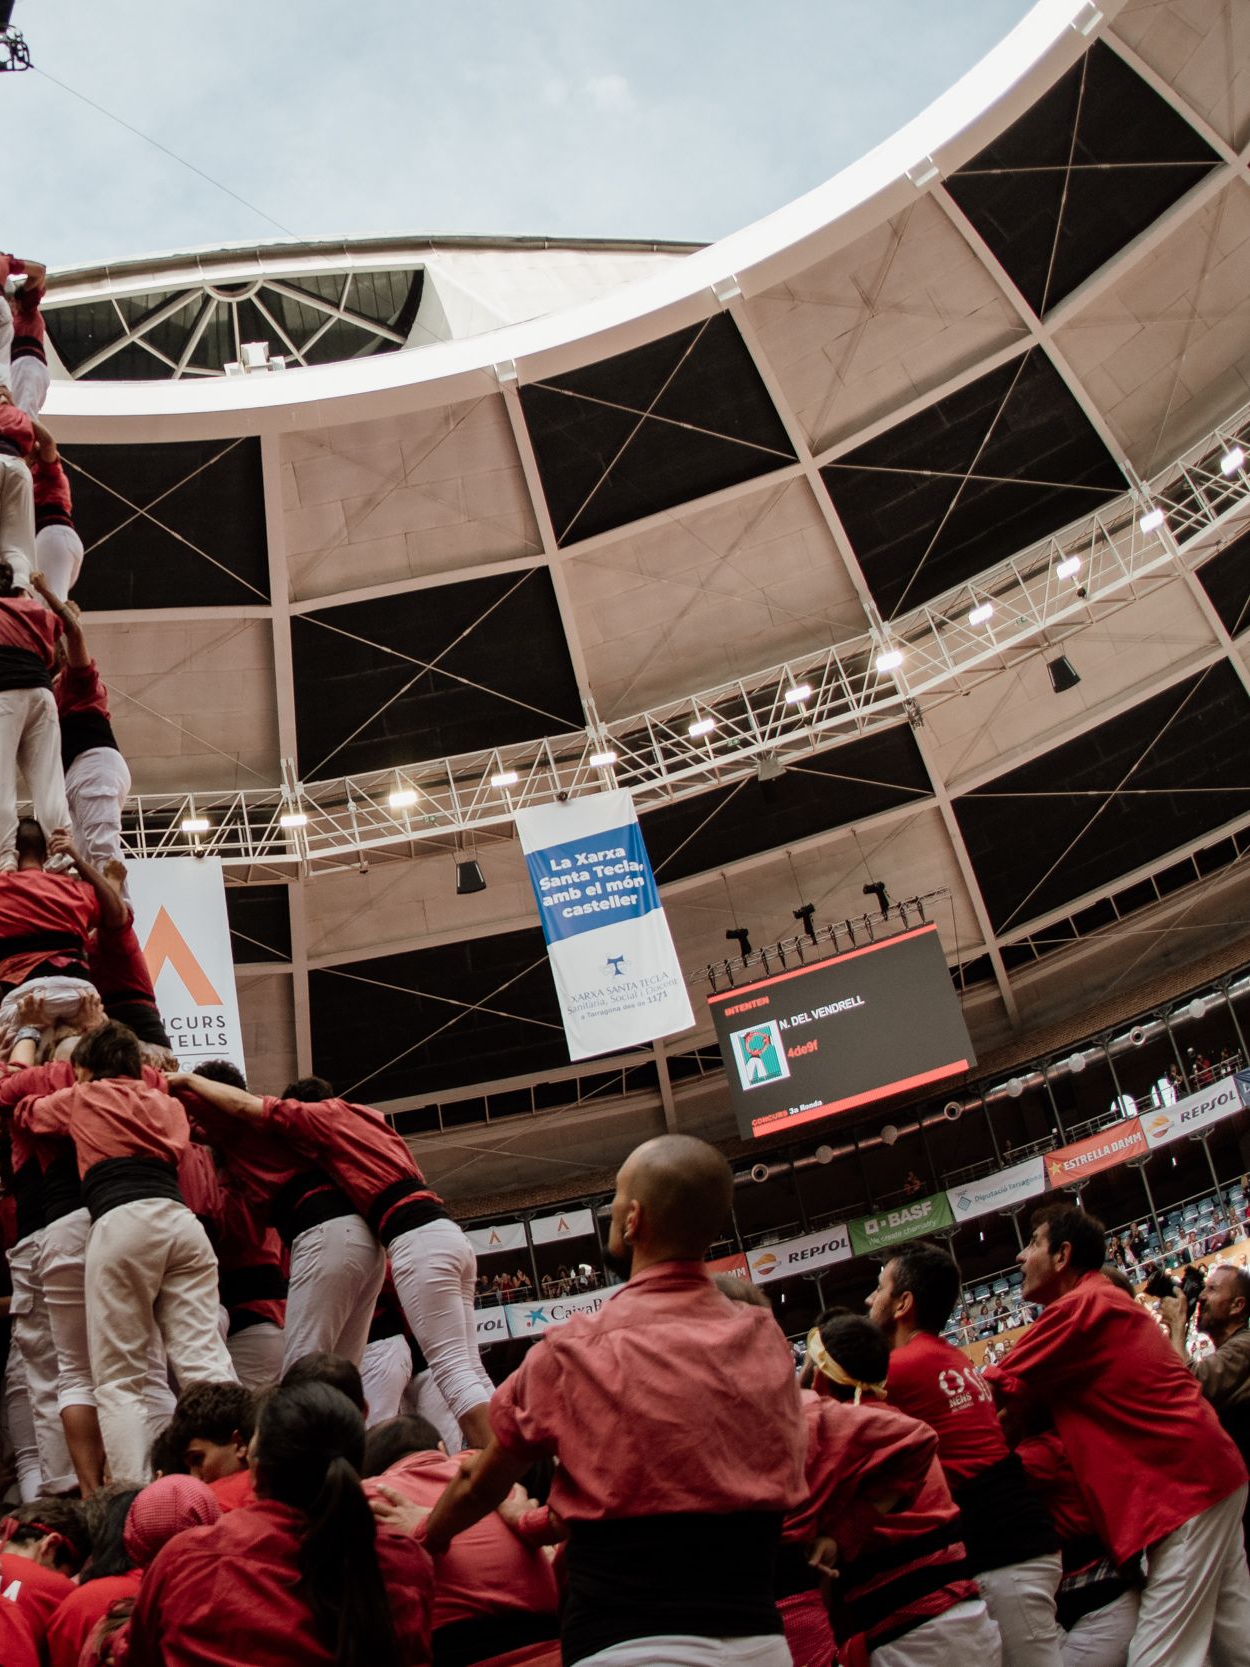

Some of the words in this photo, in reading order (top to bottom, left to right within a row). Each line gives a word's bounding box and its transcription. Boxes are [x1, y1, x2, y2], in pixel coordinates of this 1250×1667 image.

[550, 857, 571, 871] La
[576, 846, 626, 866] Xarxa
[539, 870, 590, 891] Santa
[593, 859, 644, 878] Tecla,
[542, 887, 582, 907] amb
[585, 881, 602, 896] el
[607, 876, 645, 893] món
[562, 893, 638, 918] casteller
[570, 988, 604, 1003] XARXA
[606, 981, 638, 995] SANTA
[641, 971, 669, 987] TECLA
[610, 991, 638, 1002] Social
[647, 990, 668, 1003] 1171
[779, 1018, 791, 1030] N.
[791, 1010, 812, 1027] DEL
[811, 995, 865, 1020] VENDRELL
[787, 1039, 819, 1059] 4de9f
[751, 1110, 788, 1126] CONCURS
[788, 1107, 799, 1115] 3a
[799, 1100, 823, 1112] Ronda
[1180, 1089, 1236, 1124] REPSOL
[1063, 1145, 1111, 1172] ESTRELLA
[1110, 1132, 1143, 1153] DAMM
[974, 1186, 1008, 1202] Diputació
[888, 1201, 932, 1227] BASF
[903, 1220, 936, 1235] chemistry
[788, 1237, 848, 1264] REPSOL
